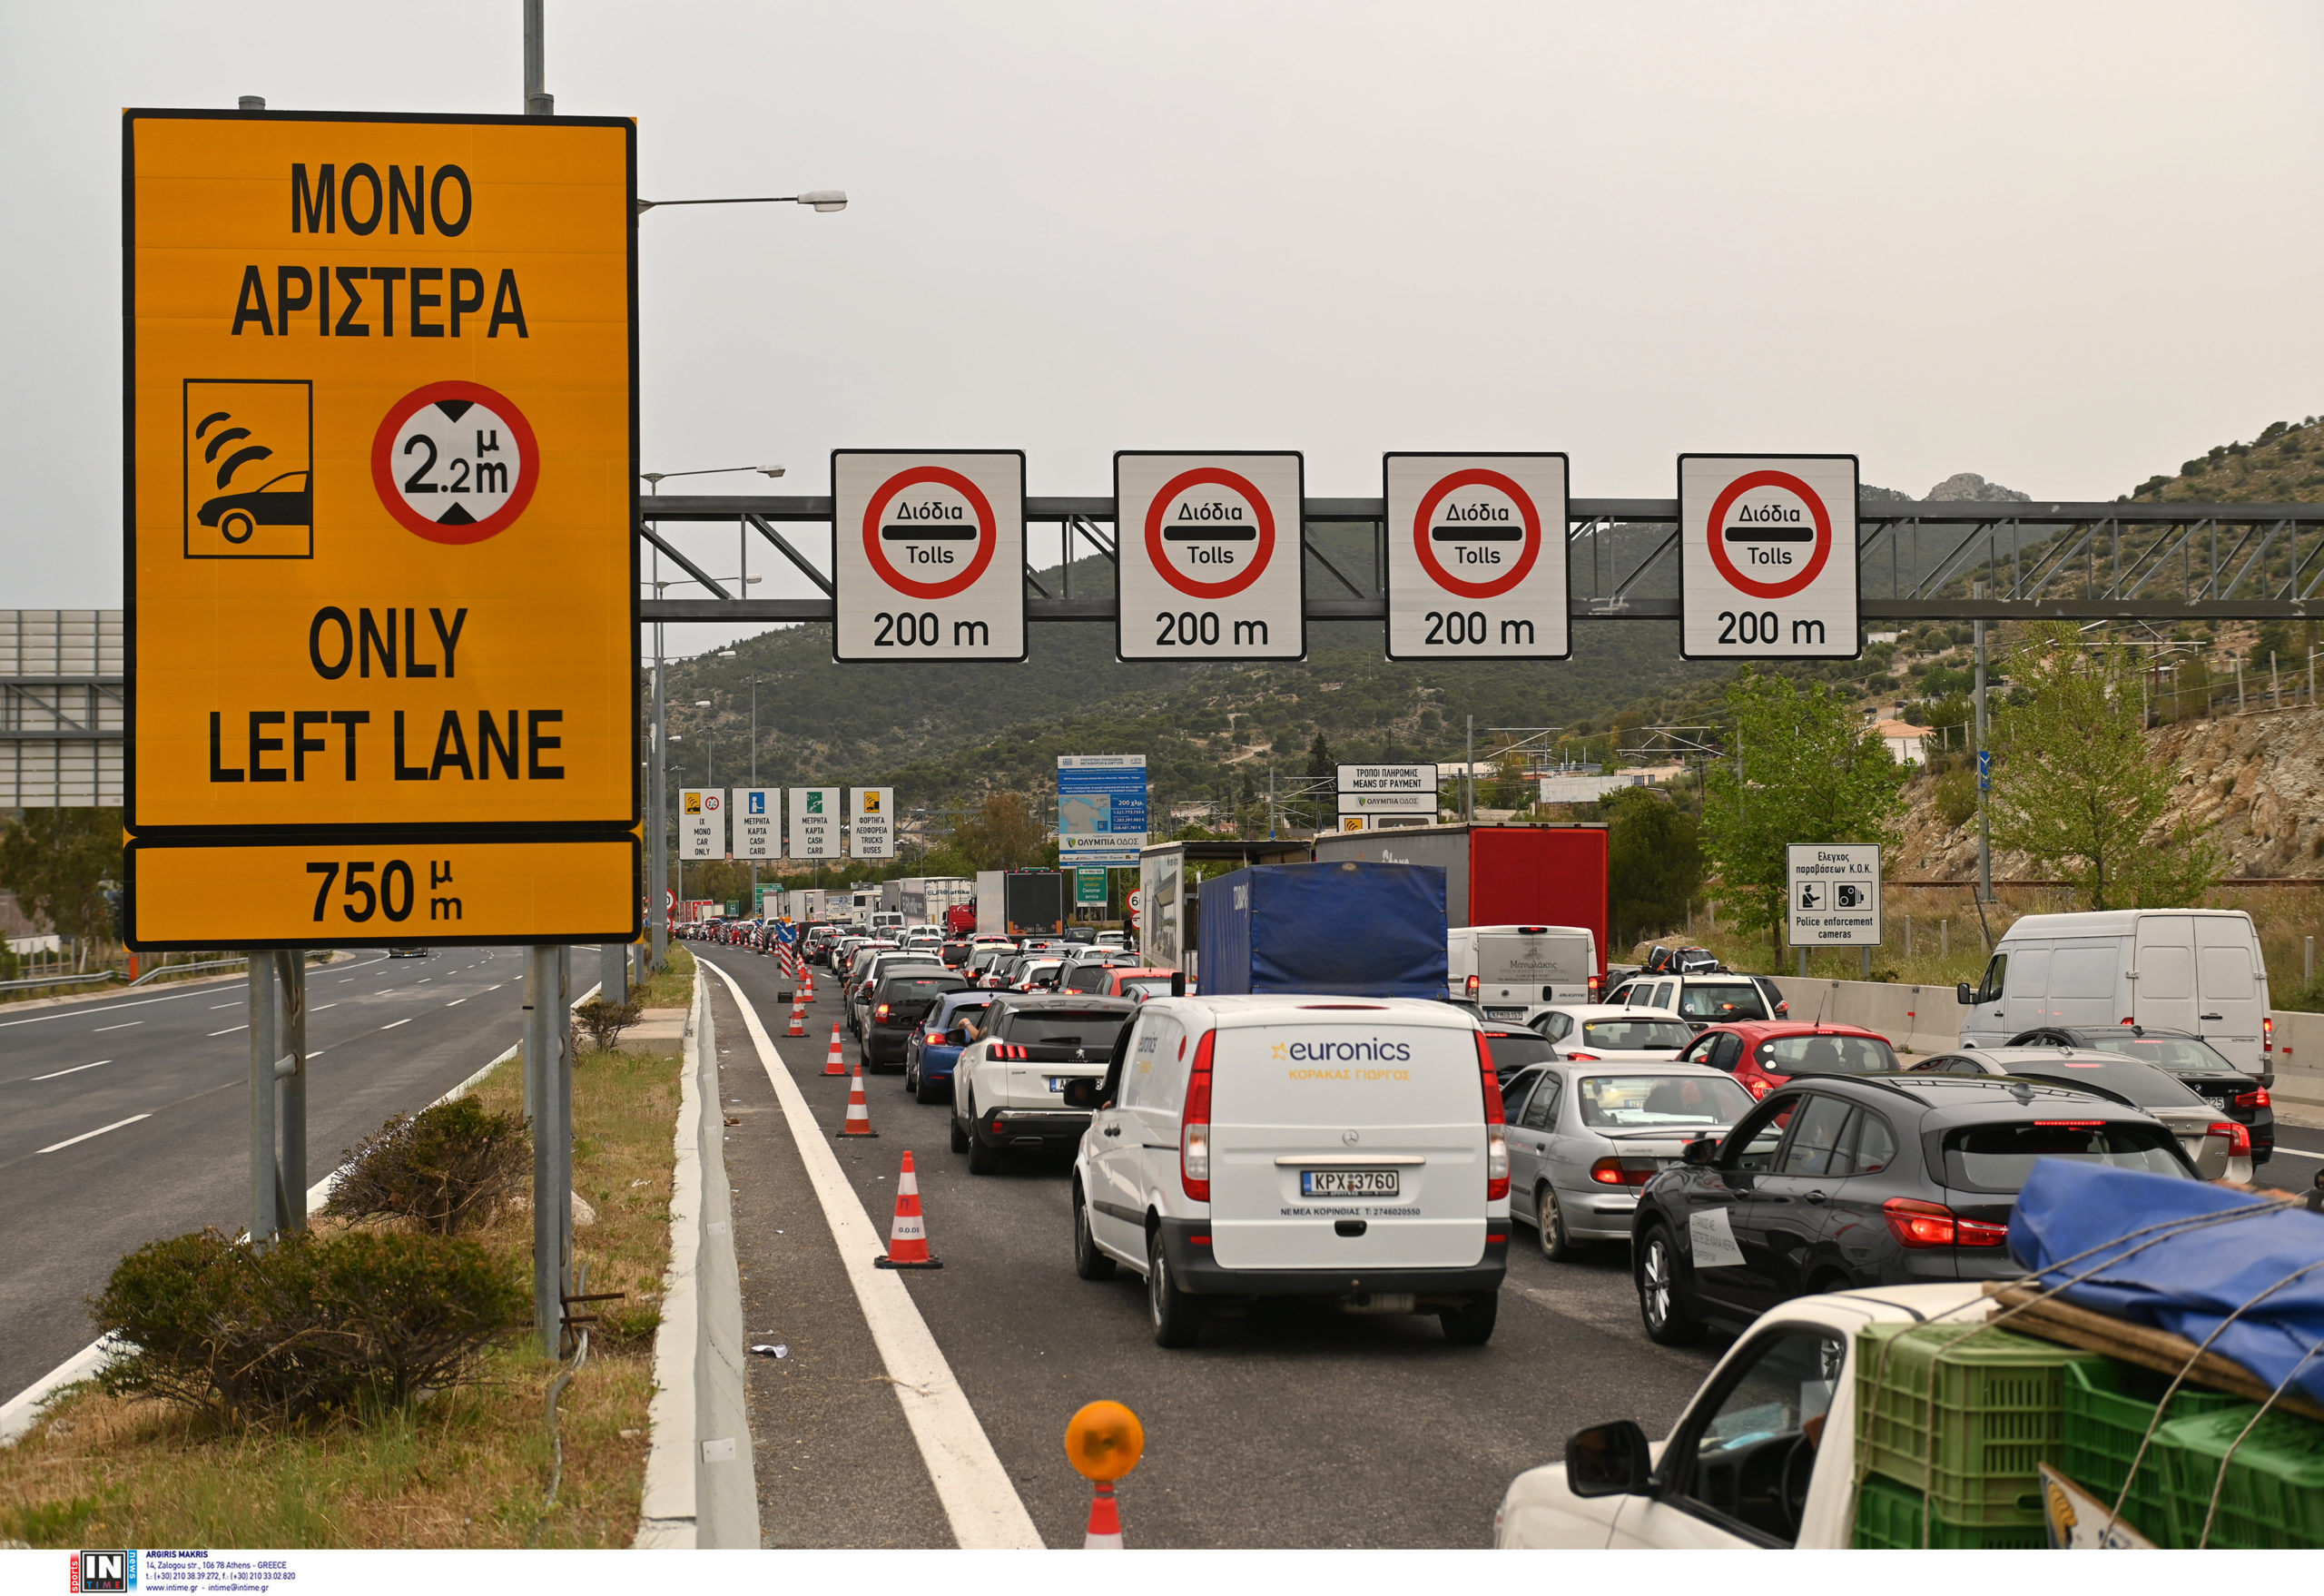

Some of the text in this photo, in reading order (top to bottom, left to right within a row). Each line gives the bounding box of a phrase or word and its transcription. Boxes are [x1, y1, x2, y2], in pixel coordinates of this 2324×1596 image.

[291, 163, 472, 237] ΜΟΝΟ
[231, 265, 529, 339] ΑΡΙΣΤΕΡΑ
[897, 502, 963, 520] Διόδια
[1178, 503, 1243, 521] Διόδια
[1446, 503, 1509, 521] Διόδια
[1738, 504, 1800, 522] Διόδια
[906, 546, 954, 565] Tolls
[1187, 547, 1235, 565] Tolls
[1454, 546, 1501, 565] Tolls
[1748, 547, 1792, 565] Tolls
[873, 612, 989, 646] 200 m
[1156, 612, 1268, 645] 200 m
[1424, 611, 1534, 645] 200 m
[1718, 611, 1825, 645] 200 m
[310, 606, 468, 680] ONLY
[210, 709, 565, 783] LEFT LANE
[1356, 769, 1418, 777] ΤΡΟΠΟΙ ΠΛΗΡΩΜΗΣ
[1353, 780, 1377, 788] MEANS
[1390, 779, 1422, 788] PAYMENT
[1818, 852, 1849, 862] Ελεγχος
[1797, 864, 1872, 875] παραβάσεων Κ.Ο.Κ.
[306, 859, 415, 923] 750
[430, 897, 462, 921] m
[1132, 897, 1140, 906] 6
[1797, 917, 1873, 926] Police enforcement
[1818, 931, 1851, 939] cameras
[1510, 960, 1558, 969] Μανωλάκης
[1289, 1037, 1411, 1061] euronics
[1289, 1069, 1411, 1080] ΚΟΡΑΚΑΣ ΓΙΩΡΓΟΣ
